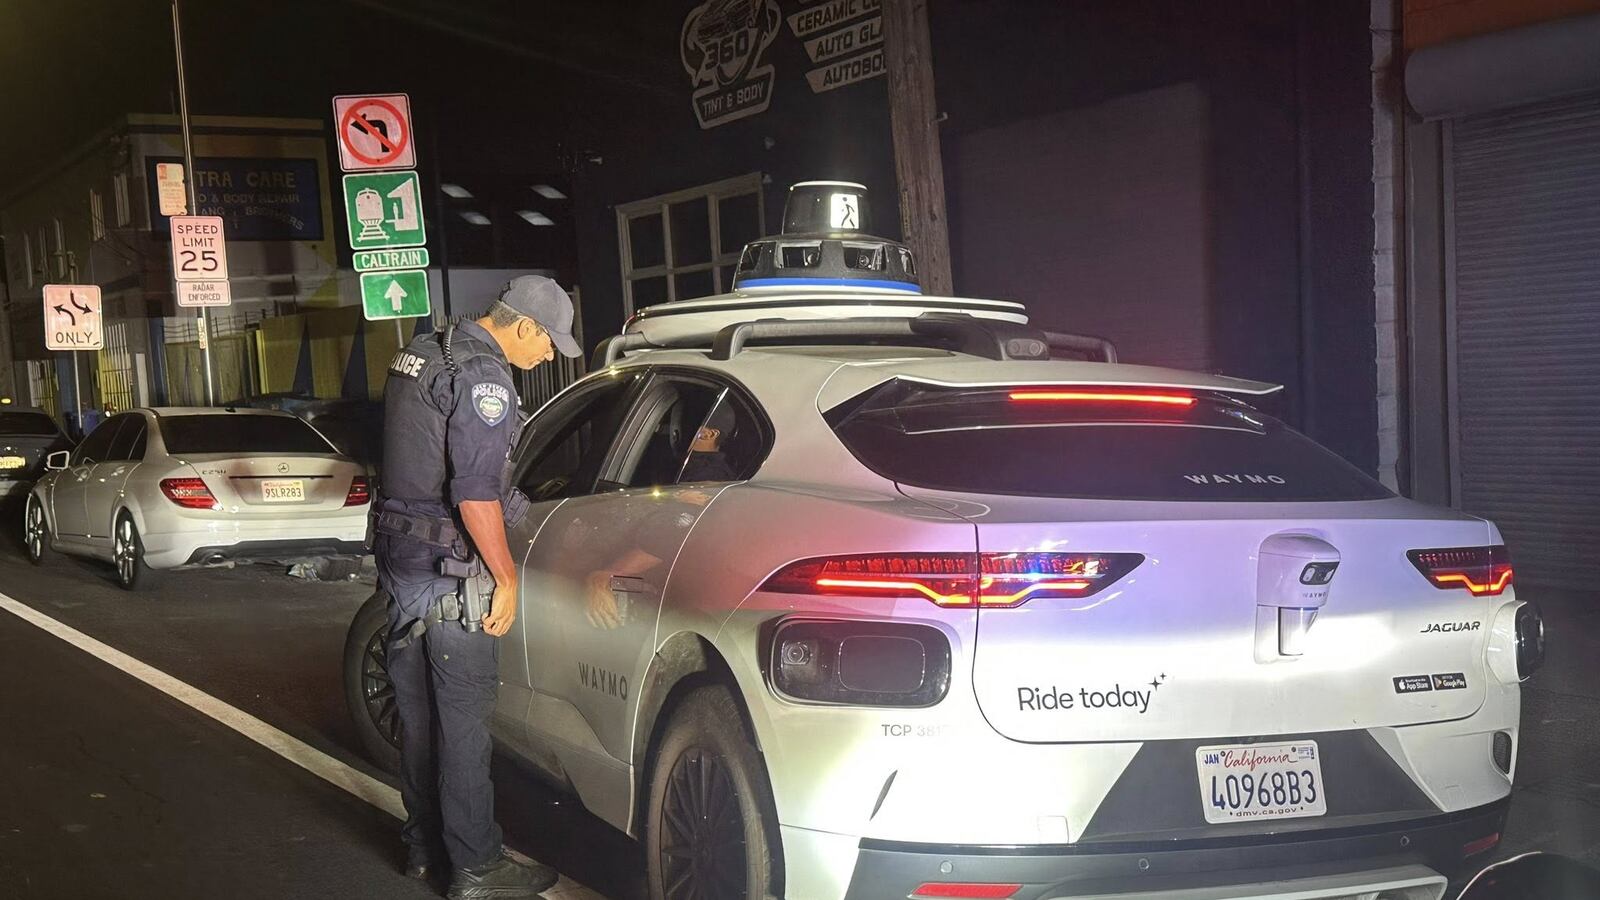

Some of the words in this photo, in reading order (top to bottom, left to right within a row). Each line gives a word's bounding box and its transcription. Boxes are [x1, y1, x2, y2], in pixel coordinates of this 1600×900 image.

[705, 29, 750, 71] 360
[815, 31, 853, 58] AUTO
[702, 96, 724, 118] TINT
[736, 81, 764, 105] BODY
[196, 171, 233, 188] TRA
[246, 171, 297, 188] CARE
[177, 224, 218, 234] SPEED
[182, 237, 215, 247] LIMIT
[180, 250, 218, 272] 25
[361, 251, 422, 268] CALTRAIN
[192, 284, 215, 292] RADAR
[188, 293, 221, 301] ENFORCED
[55, 331, 93, 344] ONLY
[390, 352, 426, 378] OLICE
[1184, 474, 1286, 484] WAYMO
[265, 487, 302, 498] 9SLR283
[1420, 621, 1481, 633] JAGUAR
[578, 661, 628, 700] WAYMO
[1017, 686, 1074, 711] Ride
[1079, 684, 1151, 714] today
[881, 724, 912, 737] TCP
[1204, 753, 1220, 765] JAN
[1224, 749, 1298, 771] California
[1212, 770, 1317, 810] 40968B3
[1236, 807, 1297, 817] dmv.ca.gov
